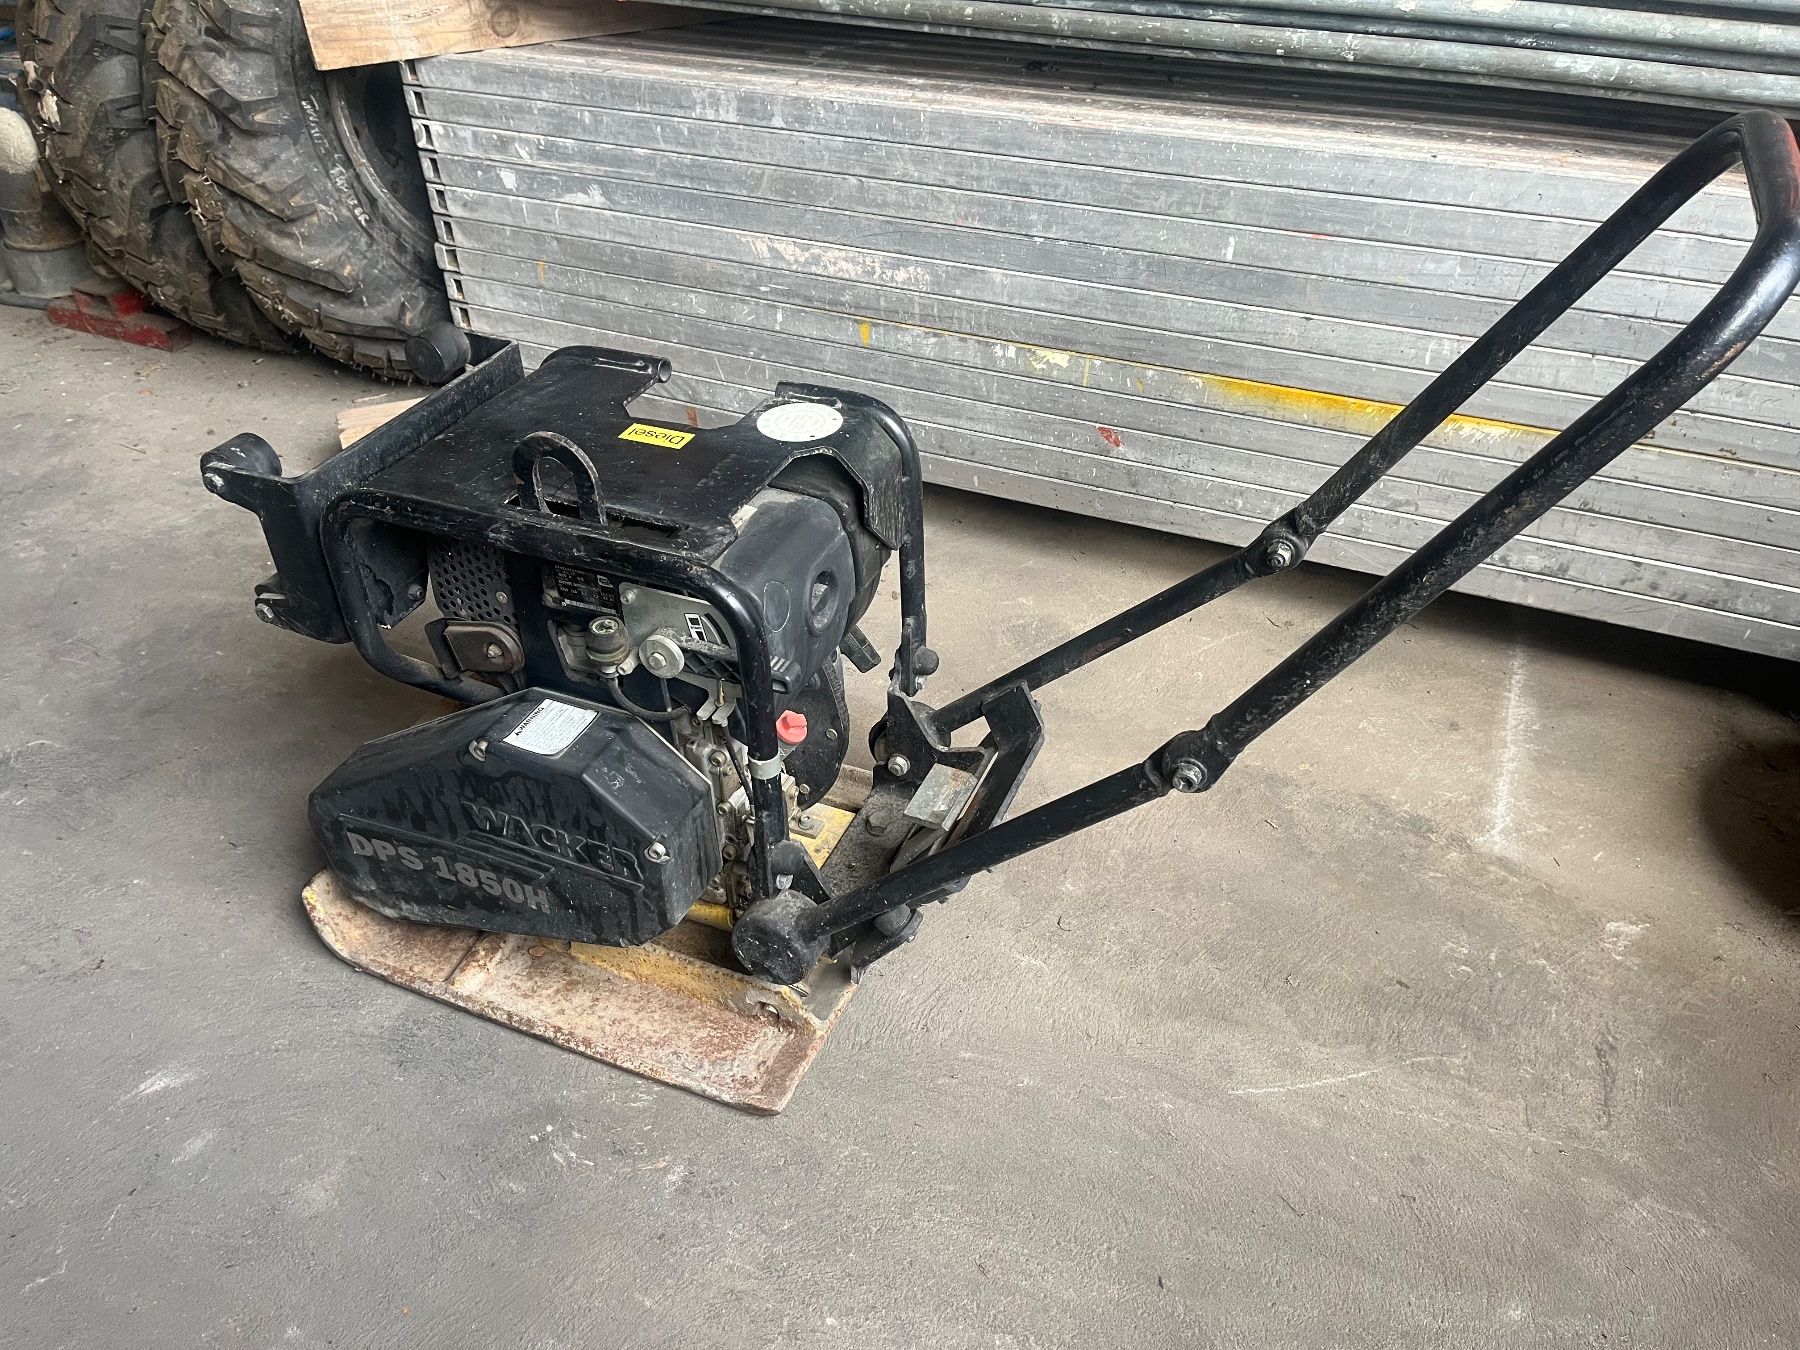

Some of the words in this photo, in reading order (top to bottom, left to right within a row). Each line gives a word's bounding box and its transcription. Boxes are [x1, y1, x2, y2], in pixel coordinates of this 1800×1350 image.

[627, 428, 685, 445] Diesel
[345, 831, 425, 871] DPS
[431, 856, 551, 914] 1850H
[461, 801, 645, 881] WACKER
